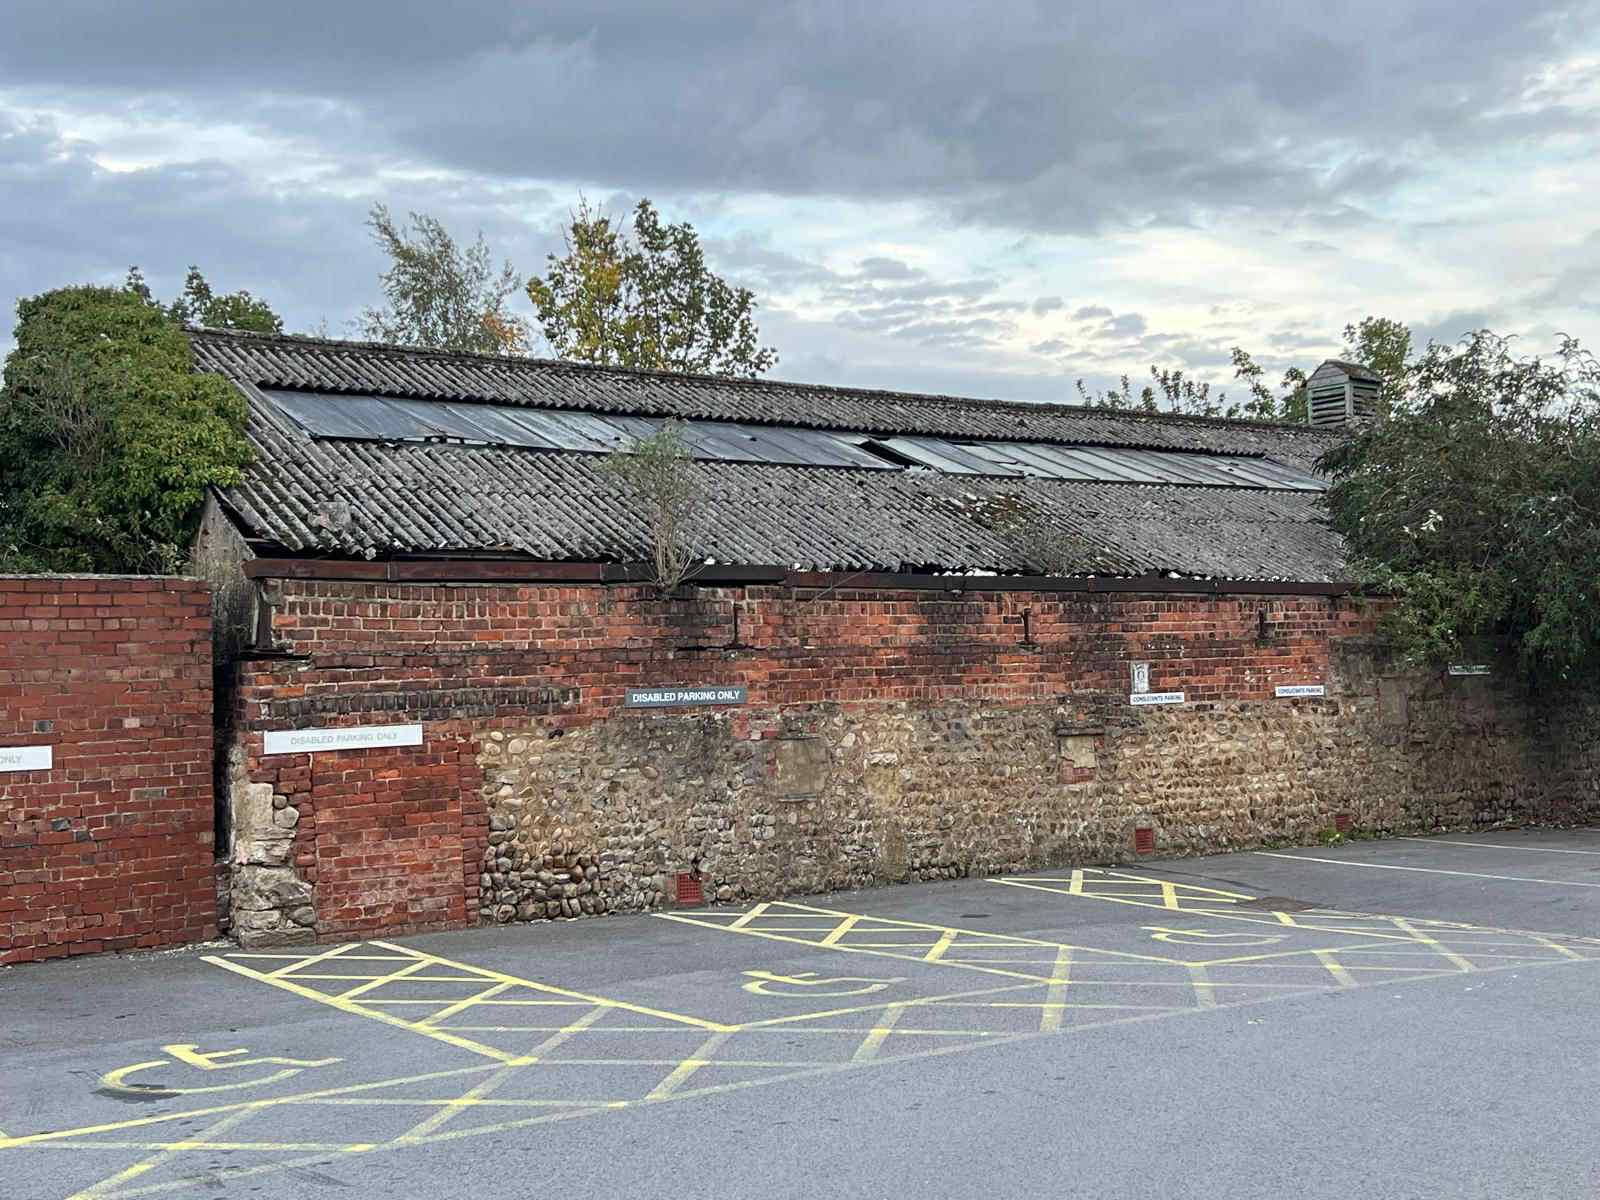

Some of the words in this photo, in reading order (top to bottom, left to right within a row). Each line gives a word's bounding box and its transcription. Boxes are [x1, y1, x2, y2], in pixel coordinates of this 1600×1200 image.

[632, 693, 676, 702] DISABLED
[678, 691, 716, 701] PARKING
[717, 690, 740, 700] ONLY
[290, 735, 334, 746] DISABLED
[336, 733, 374, 743] PARKING
[376, 732, 398, 741] ONLY
